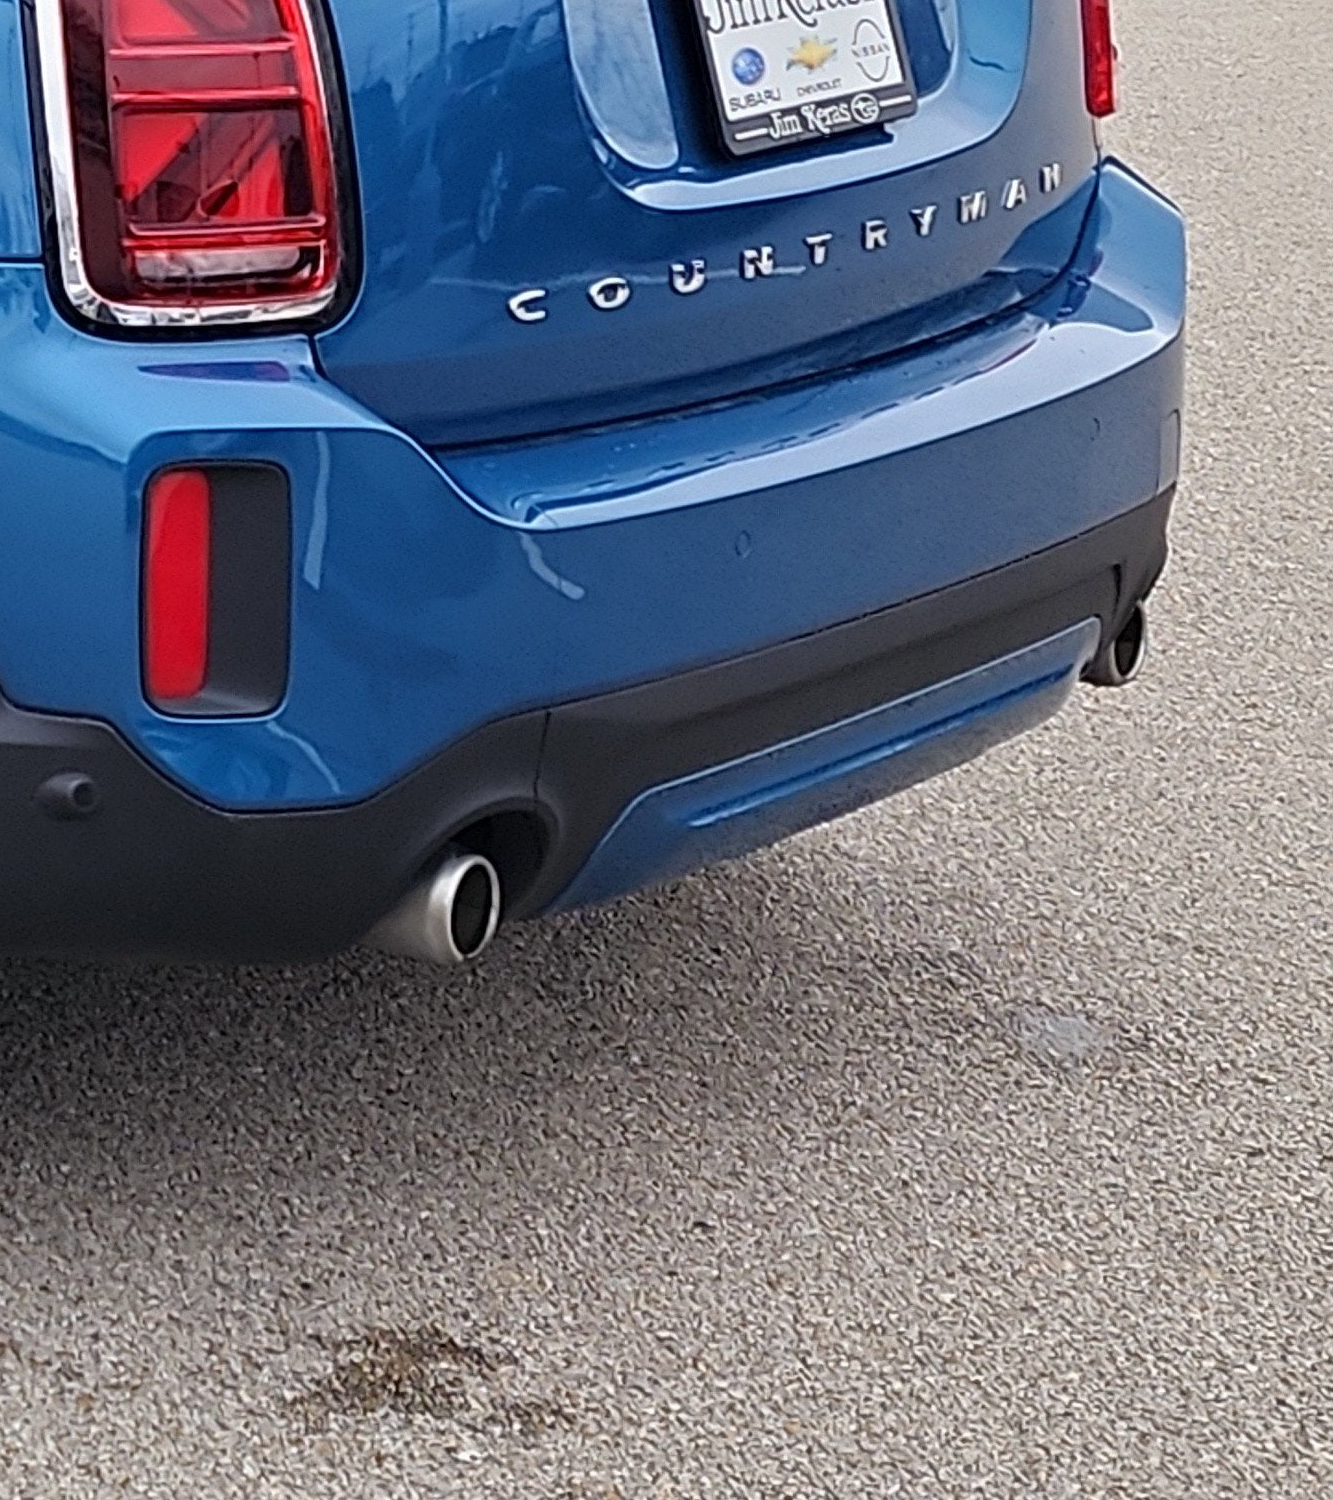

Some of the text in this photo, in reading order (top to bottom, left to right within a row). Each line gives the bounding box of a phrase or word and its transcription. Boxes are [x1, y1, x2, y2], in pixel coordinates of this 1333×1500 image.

[769, 103, 851, 139] Jim Keras
[508, 162, 1063, 323] COUNTRYMAN
